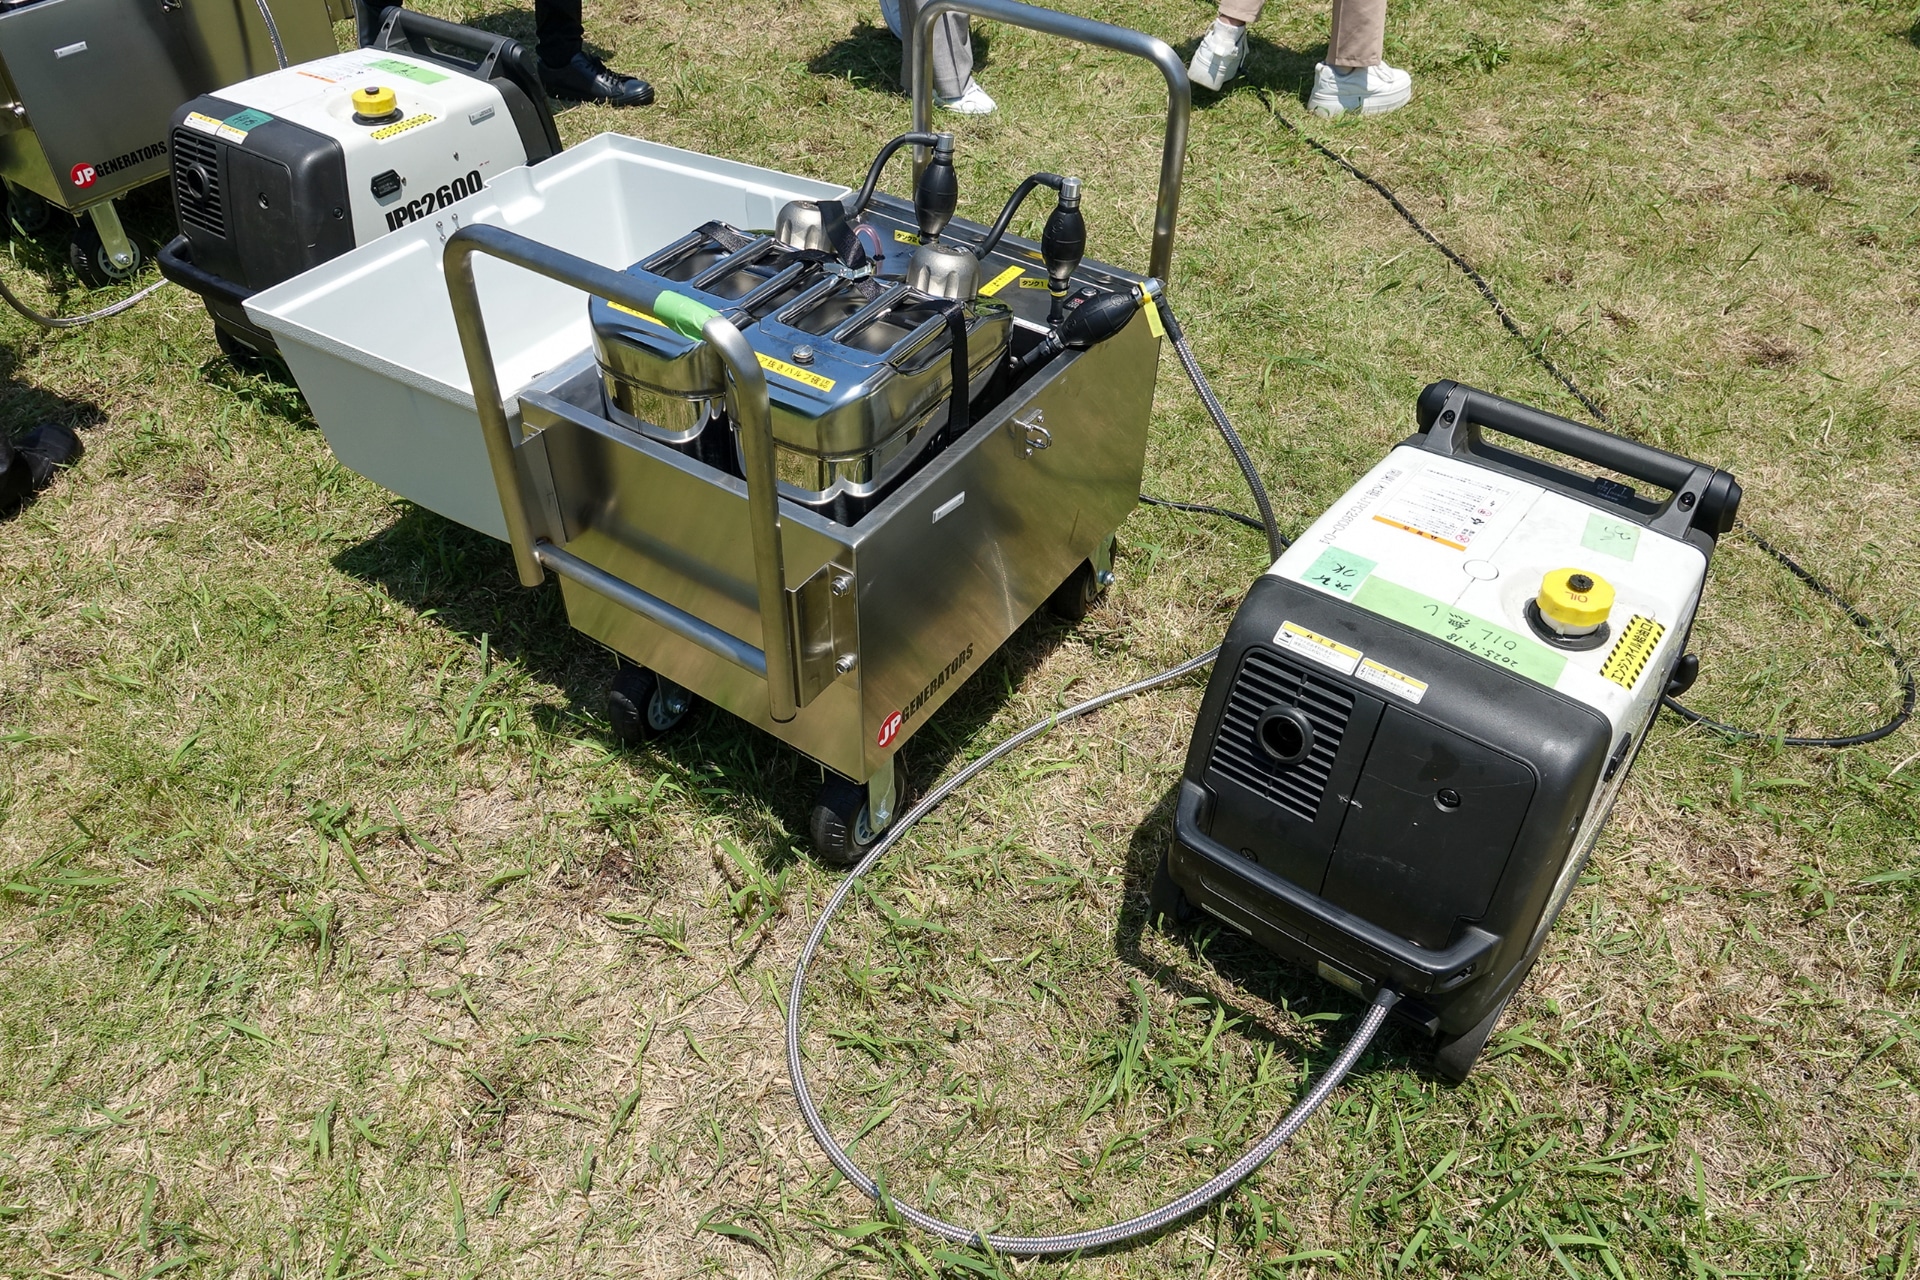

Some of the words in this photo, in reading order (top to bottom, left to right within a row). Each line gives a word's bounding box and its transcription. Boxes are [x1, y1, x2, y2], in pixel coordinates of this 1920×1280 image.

[74, 167, 95, 186] JP
[94, 140, 168, 178] GENERATORS
[1332, 562, 1359, 578] OK
[1565, 590, 1589, 604] OIL
[1445, 632, 1519, 668] 2025.4.18
[1481, 627, 1518, 651] OIL
[1610, 621, 1654, 682] エンジンオイル給油口
[879, 714, 902, 746] JP
[901, 642, 974, 725] GENERATORS
